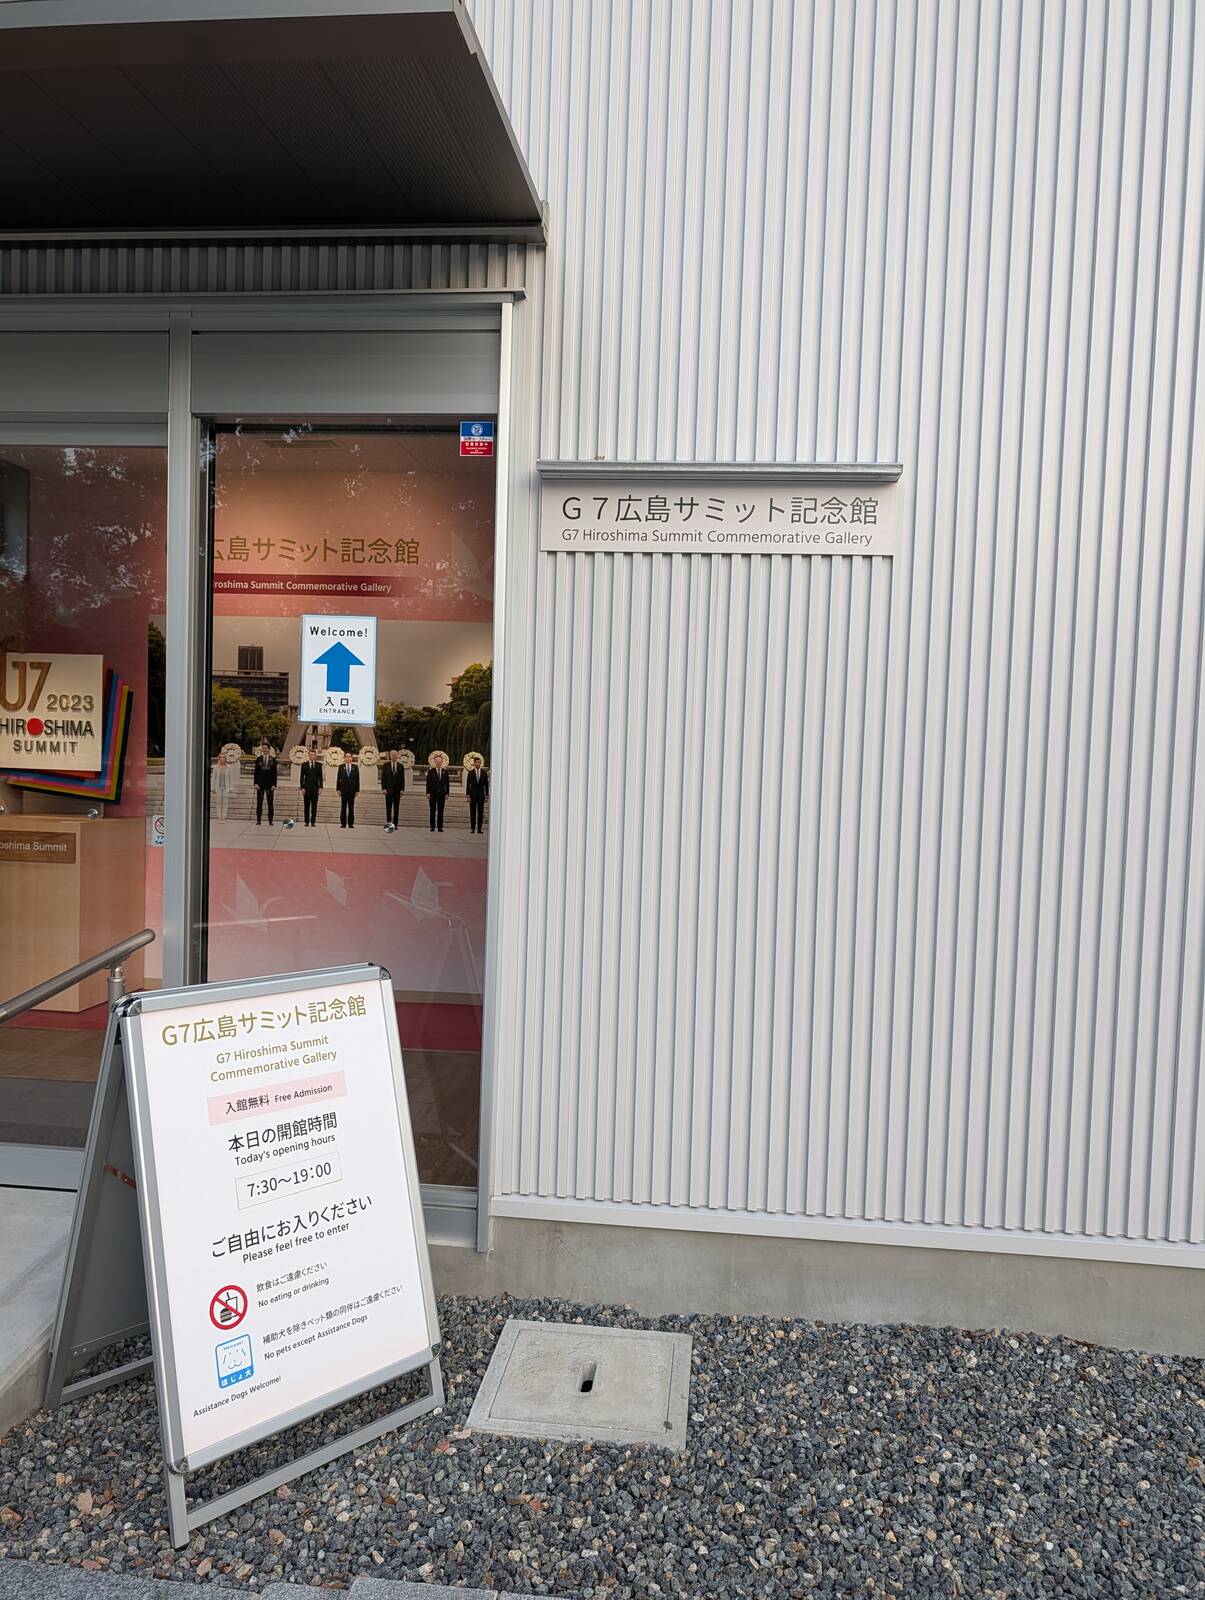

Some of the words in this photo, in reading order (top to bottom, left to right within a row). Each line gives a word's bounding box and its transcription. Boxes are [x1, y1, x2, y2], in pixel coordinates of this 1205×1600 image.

[562, 494, 879, 525] G7広島サミット記念館
[562, 529, 580, 542] G7
[583, 528, 648, 543] Hiroshima
[652, 529, 703, 543] Summit
[707, 530, 821, 544] Commemorative
[824, 531, 873, 547] Gallery
[250, 580, 284, 590] Summit
[286, 580, 359, 592] Commemorative
[360, 581, 392, 593] Gallery
[310, 626, 368, 638] Welcome!
[47, 694, 95, 712] 2023
[319, 707, 355, 715] ENTRANCE
[325, 696, 350, 707] 入口
[13, 739, 79, 755] SUMMIT
[32, 841, 67, 852] Summit
[161, 995, 367, 1046] G7広島サミット記念館
[216, 1052, 231, 1064] G7
[234, 1042, 288, 1061] Hiroshima
[290, 1035, 329, 1051] Summit
[210, 1058, 300, 1083] Commemorative
[302, 1050, 338, 1066] Gallery
[225, 1093, 270, 1115] 入館無料
[274, 1092, 292, 1103] Free
[293, 1084, 332, 1099] Admission
[228, 1111, 338, 1153] 本日の開館時間
[235, 1150, 271, 1167] Today's
[272, 1140, 310, 1158] opening
[311, 1133, 336, 1148] hours
[211, 1195, 372, 1258] ご自由にお入りください
[242, 1247, 273, 1263] Please
[275, 1240, 293, 1253] feel
[295, 1234, 313, 1247] free
[315, 1230, 325, 1239] to
[326, 1222, 350, 1237] enter
[256, 1262, 328, 1293] 飲食はご遠慮ください
[258, 1300, 268, 1308] No
[270, 1290, 292, 1304] eating
[293, 1287, 301, 1295] or
[301, 1277, 330, 1293] drinking
[264, 1351, 275, 1361] No
[276, 1343, 292, 1357] pets
[292, 1334, 316, 1350] except
[317, 1322, 351, 1340] Assistance
[351, 1314, 368, 1327] Dogs
[193, 1394, 230, 1418] Assistance
[230, 1388, 249, 1405] Dogs
[249, 1375, 282, 1395] Welcome!
